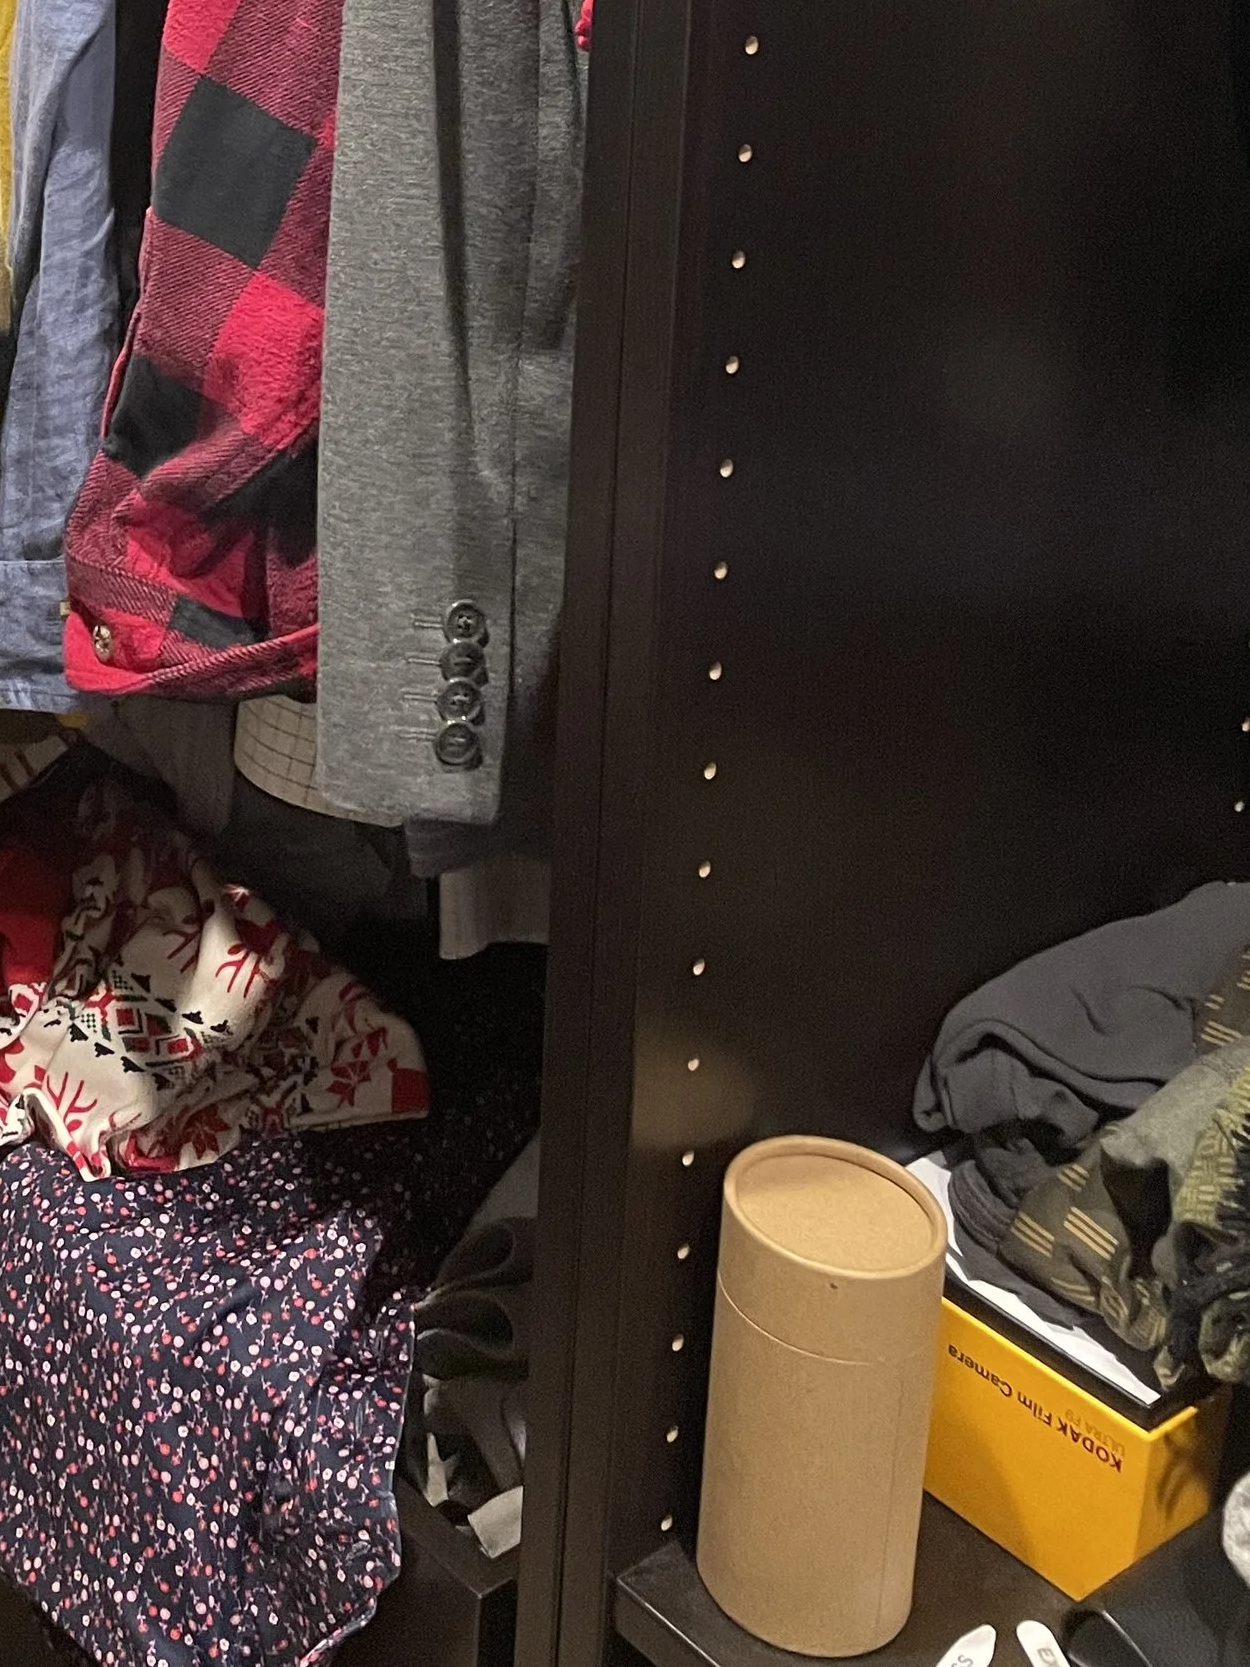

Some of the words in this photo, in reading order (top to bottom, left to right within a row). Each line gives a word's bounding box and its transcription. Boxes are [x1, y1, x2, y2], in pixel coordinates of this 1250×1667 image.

[948, 1344, 1013, 1398] Camera
[1017, 1390, 1053, 1427] Film
[1065, 1408, 1082, 1427] F9
[1057, 1416, 1122, 1473] KODAK
[1085, 1420, 1126, 1458] ULTRA
